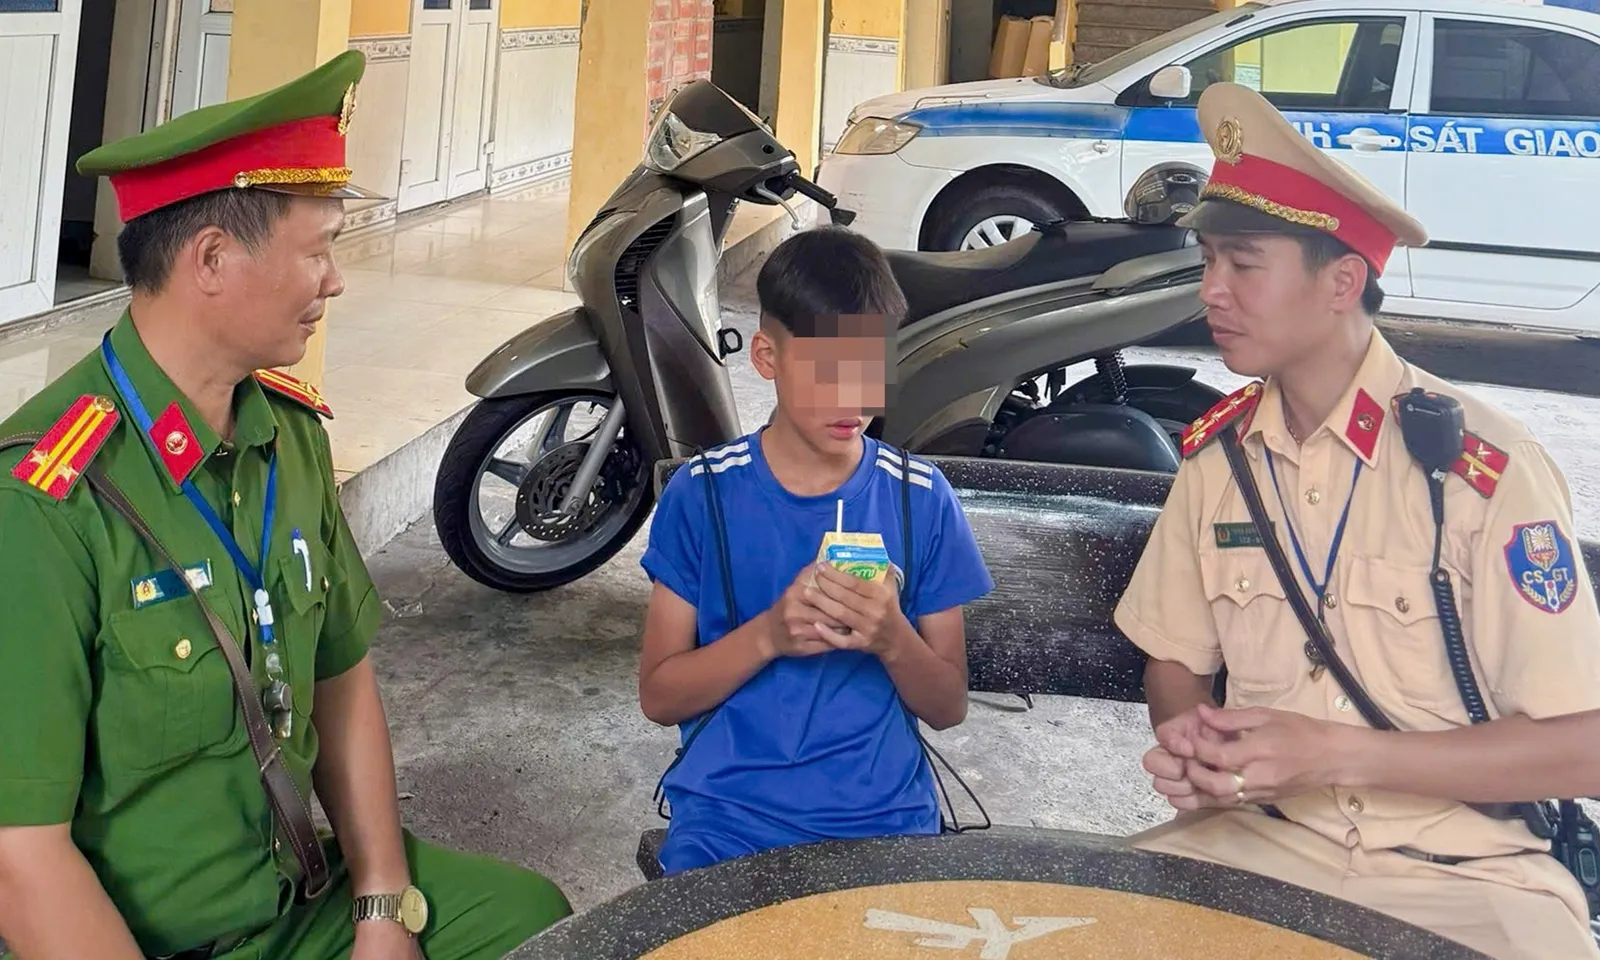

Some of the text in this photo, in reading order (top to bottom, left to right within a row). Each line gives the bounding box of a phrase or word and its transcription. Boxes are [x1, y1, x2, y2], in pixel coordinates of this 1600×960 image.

[1409, 121, 1483, 153] SÁT
[1504, 128, 1600, 158] GIAO
[1522, 567, 1568, 584] CS GT
